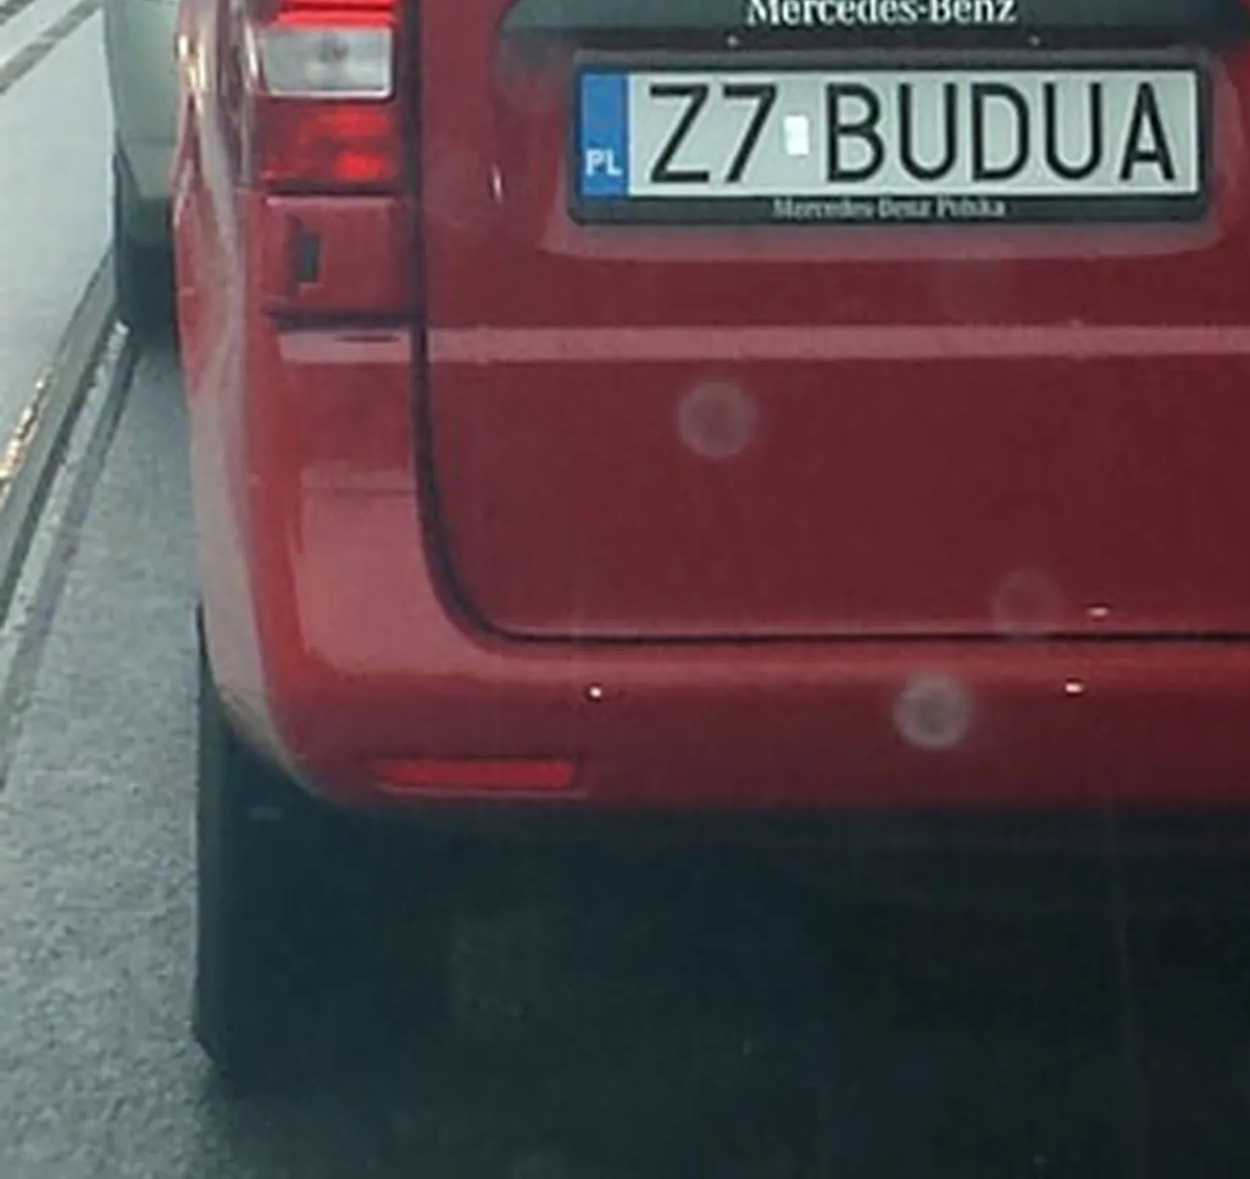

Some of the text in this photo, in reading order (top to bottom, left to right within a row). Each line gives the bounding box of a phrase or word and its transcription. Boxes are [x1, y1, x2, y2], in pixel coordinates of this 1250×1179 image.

[585, 149, 622, 176] PL
[649, 81, 1175, 184] Z7 BUDUA
